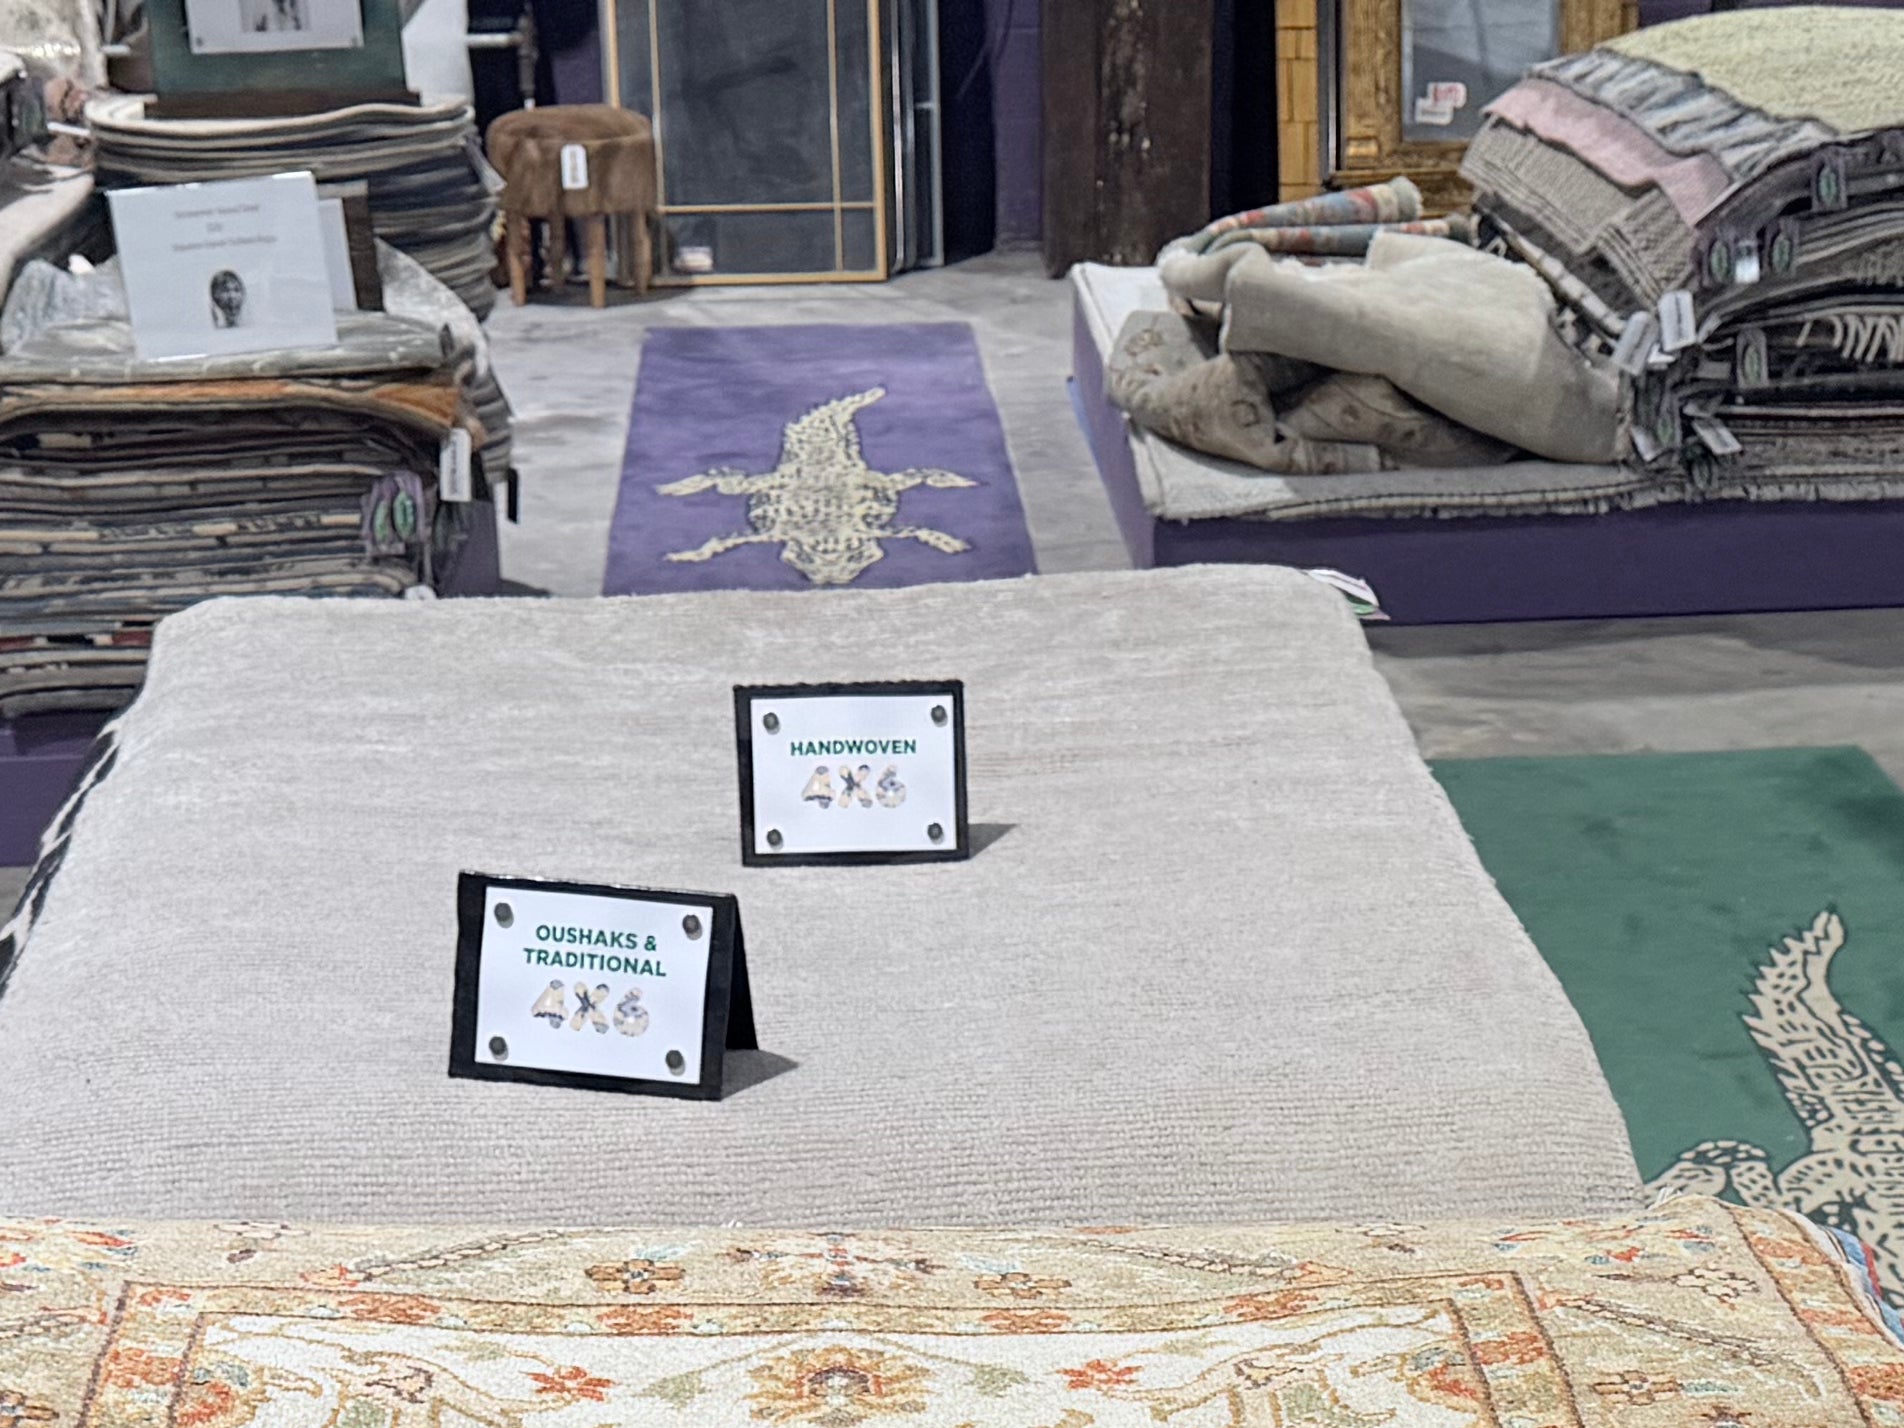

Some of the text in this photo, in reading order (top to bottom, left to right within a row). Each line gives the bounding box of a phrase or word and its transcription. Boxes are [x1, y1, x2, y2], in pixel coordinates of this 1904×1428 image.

[790, 739, 917, 756] HANDWOVEN
[801, 764, 907, 809] 4X6
[535, 924, 657, 952] OUSHAKS &
[523, 947, 667, 977] TRADITIONAL
[531, 979, 650, 1037] 4X6
